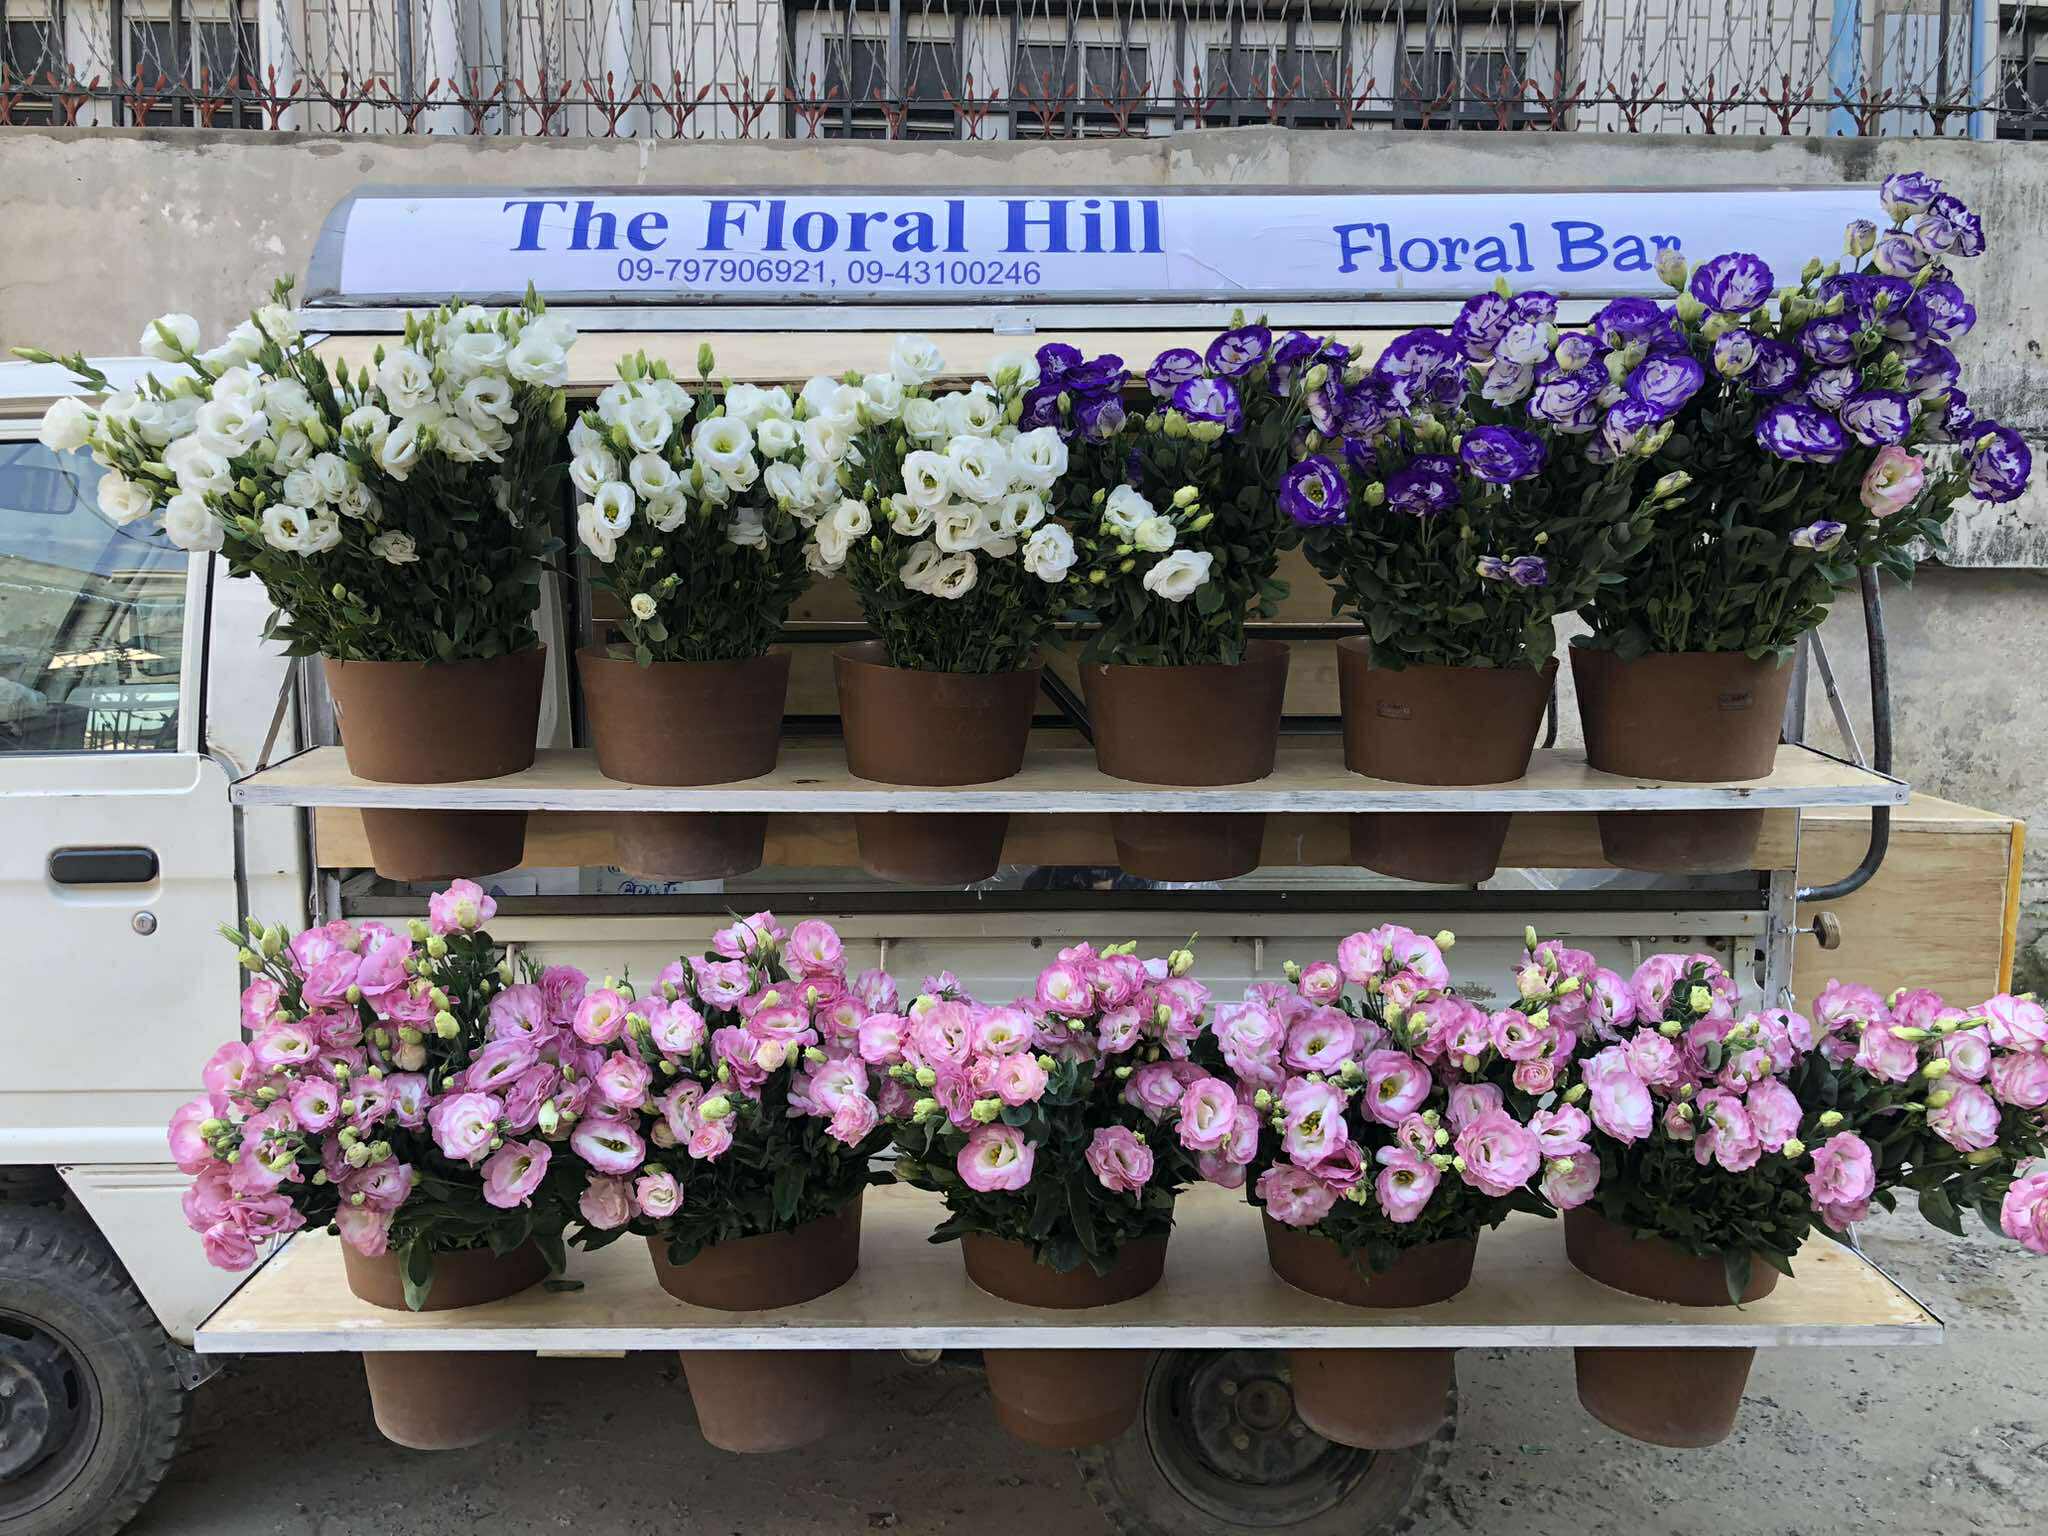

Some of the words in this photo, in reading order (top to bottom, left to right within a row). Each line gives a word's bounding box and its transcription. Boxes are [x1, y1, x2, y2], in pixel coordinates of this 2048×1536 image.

[503, 200, 669, 251] The
[696, 199, 969, 253] Floral
[998, 198, 1165, 253] Hill
[1333, 222, 1535, 273] Floral
[1551, 220, 1681, 272] Bar
[617, 258, 836, 287] 09-797906921,
[847, 260, 1041, 285] 09-43100246
